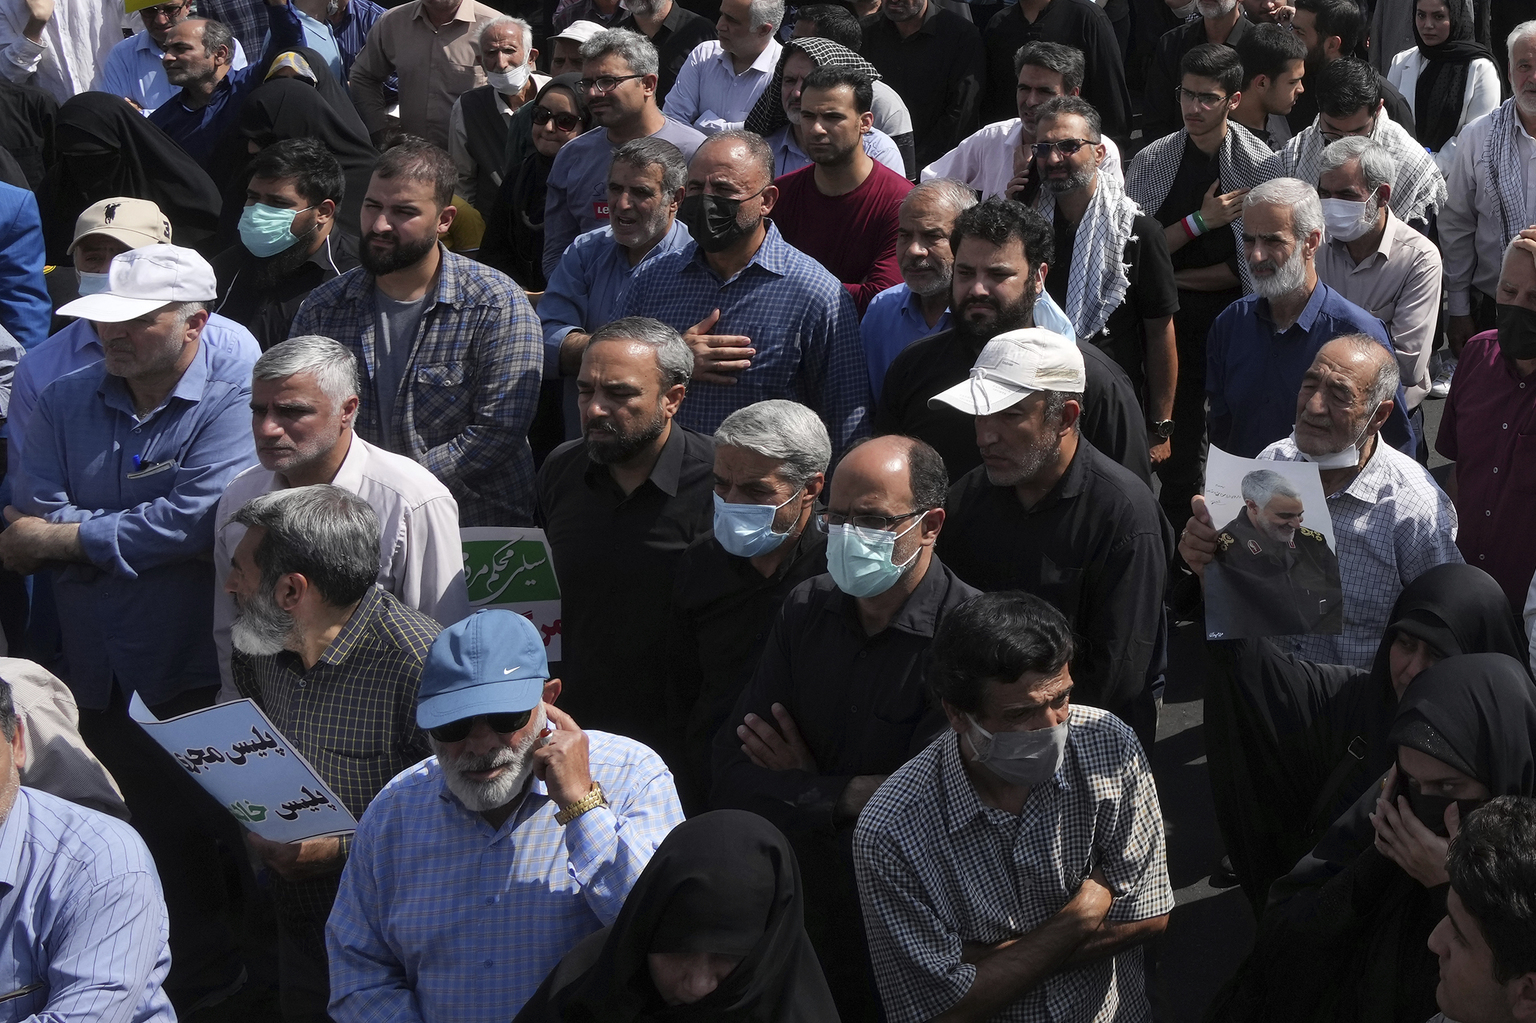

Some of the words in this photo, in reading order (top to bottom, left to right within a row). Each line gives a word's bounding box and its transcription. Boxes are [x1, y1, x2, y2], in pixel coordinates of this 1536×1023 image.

[486, 535, 525, 593] محکم
[225, 725, 286, 766] پلیس
[275, 785, 338, 821] پلیس
